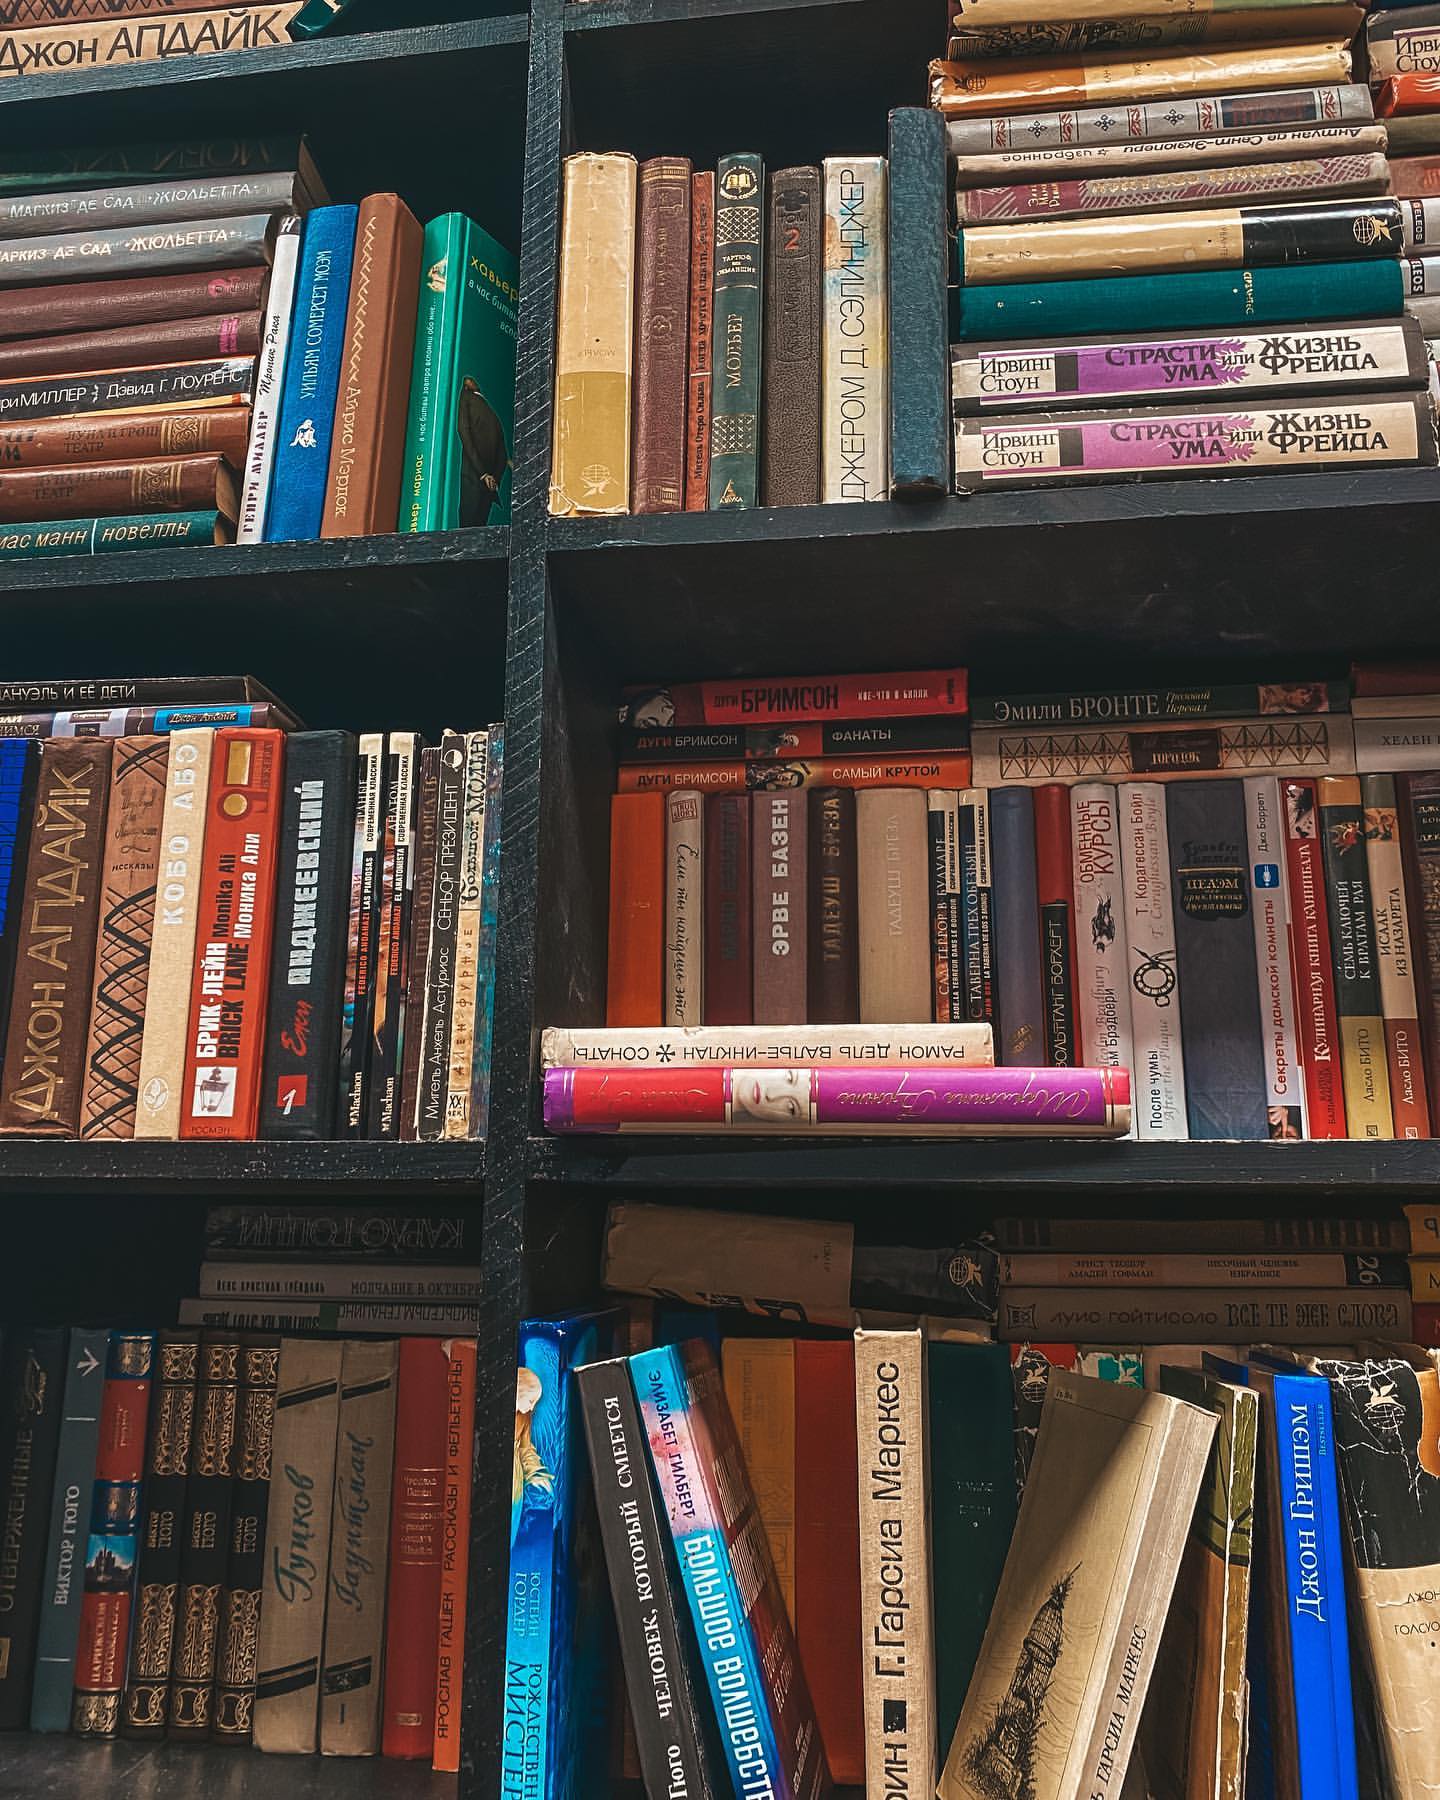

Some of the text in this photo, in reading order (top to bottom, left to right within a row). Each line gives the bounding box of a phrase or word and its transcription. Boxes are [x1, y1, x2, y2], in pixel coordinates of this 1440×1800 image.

[106, 9, 281, 61] АПДАЙК
[1000, 150, 1092, 162] избранное
[76, 184, 251, 213] ДЕ САД ЖЮЛЬЕТТА
[1413, 202, 1423, 241] GELEOS
[54, 227, 229, 261] ДЕ САД ЖЮЛЬЕТТА
[783, 228, 800, 250] 2
[471, 256, 519, 302] хавьер
[300, 250, 331, 399] УИЛЬЯМ СОМЕРСЕТ МОЭМ
[725, 314, 744, 389] МОЛЬЕР
[840, 169, 866, 500] ДЖЕРОМ Д. СЭЛИНДЖЕР
[1257, 336, 1362, 356] ЖИЗНЬ
[980, 355, 1051, 375] Ирвинг
[980, 375, 1039, 394] Стоун
[1105, 345, 1216, 366] СТРАСТИ
[1164, 363, 1217, 384] УМА
[1223, 352, 1256, 367] или
[1260, 351, 1379, 375] ФРЕЙДА
[21, 367, 242, 406] МИЛЛЕР Дэвид ЛОУРЕНС
[64, 443, 104, 456] ТЕАТР
[244, 313, 281, 533] ГЕНРИ МИЛЛЕР Тропик Рака
[334, 387, 361, 517] Айрис Мэрдок
[982, 431, 1057, 451] Ирвинг
[1110, 421, 1223, 443] СТРАСТИ
[1169, 440, 1226, 460] УМА
[1229, 428, 1263, 443] или
[1267, 412, 1372, 433] ЖИЗНЬ
[1268, 428, 1388, 454] ФРЕЙДА
[412, 454, 424, 496] мариас
[982, 450, 1043, 468] Стоун
[33, 485, 73, 500] ТЕАТР
[36, 522, 191, 548] манн новеллы
[64, 684, 136, 700] И ЕЁ ДЕТИ
[713, 685, 840, 713] ДУГИ БРИМСОН
[994, 694, 1160, 722] Эмили БРОНТЕ
[674, 728, 893, 748] БРИМСОН ФАНАТЫ
[366, 754, 378, 842] СОВРЕМЕННАЯ КЛАССИКА
[398, 755, 409, 842] СОВРЕМЕННАЯ КЛАССИКА
[637, 761, 941, 788] ДУГИ БРИМСОН САМЫЙ КРУТОЙ
[162, 742, 199, 927] КОБО АБЭ
[388, 780, 399, 831] АНАТОМ
[27, 762, 95, 972] АПДАЙК
[436, 782, 459, 930] СЕНЬОР ПРЕЗИДЕНТ
[676, 843, 700, 881] Если
[1076, 800, 1096, 884] ОБМЕННЫЕ
[1091, 799, 1114, 876] КУРСЫ
[1129, 792, 1151, 900] Корагессан Бойл
[1257, 831, 1269, 853] Джо
[212, 854, 236, 938] Monika Ali
[233, 833, 261, 939] Моника Али
[676, 887, 688, 912] ты
[770, 799, 790, 956] ЭРВЕ БАЗЕН
[821, 797, 842, 962] ТАДЕУШ БРЕЗА
[886, 869, 904, 937] ТАДЕУШ
[281, 779, 324, 1057] Ежи АНДЖЕЕВСКИЙ
[358, 857, 373, 995] FEDERICO ANDAHAZI LAS PIADOSAS
[390, 905, 401, 976] FEDERICO ANDAHAZI
[963, 843, 982, 1002] ТАВЕРНА ТРЕХ ОБЕЗЬЯН
[1335, 879, 1353, 941] КЛЮЧЕЙ
[1350, 879, 1371, 980] К ВРАТАМ РАЯ
[1375, 908, 1391, 957] ИСААК
[1388, 887, 1408, 977] ИЗ НАЗАРЕТА
[217, 943, 250, 1060] BRICK LANE
[1103, 987, 1120, 1048] Брэдбери
[1263, 899, 1290, 1096] Секреты дамской комнаты
[424, 946, 450, 1119] Мигель Анхель Астуриас
[571, 1044, 965, 1060] РАМОН ДЕЛЬ ВАЛЬЕ-ИНКЛАН СОНАТЫ
[348, 1071, 362, 1117] Machaon
[1147, 1050, 1164, 1129] После чумы
[1357, 1027, 1375, 1104] Ласло БИТО
[1394, 1030, 1416, 1105] Ласло БИТО
[380, 1076, 395, 1122] Machaon
[361, 1217, 465, 1249] КАРЛО
[1357, 1255, 1382, 1284] 26
[1108, 1302, 1289, 1328] ГОЙТИСОЛО ТЕ
[648, 1369, 697, 1520] ЭЛИЗАБЕТ ГИЛБЕРТ
[870, 1361, 907, 1502] Маркес
[1, 1429, 33, 1613] ОТВЕРЖЕННЫЕ
[53, 1484, 81, 1605] ВИКТОР ГЮГО
[274, 1463, 317, 1602] Гуцков
[332, 1431, 374, 1611] Гауптман
[437, 1357, 464, 1740] ЯРОСЛАВ ГАШЕК РАССКАЗЫ И ФЕЛЬЕТОНЫ
[512, 1571, 527, 1637] ГОРДЕР
[527, 1572, 542, 1636] ЮСТЕЙН
[602, 1395, 689, 1799] Гюго ЧЕЛОВЕК, КОТОРЫЙ СМЕЕТСЯ
[1095, 1624, 1148, 1786] ГАРСИА МАРКЕС
